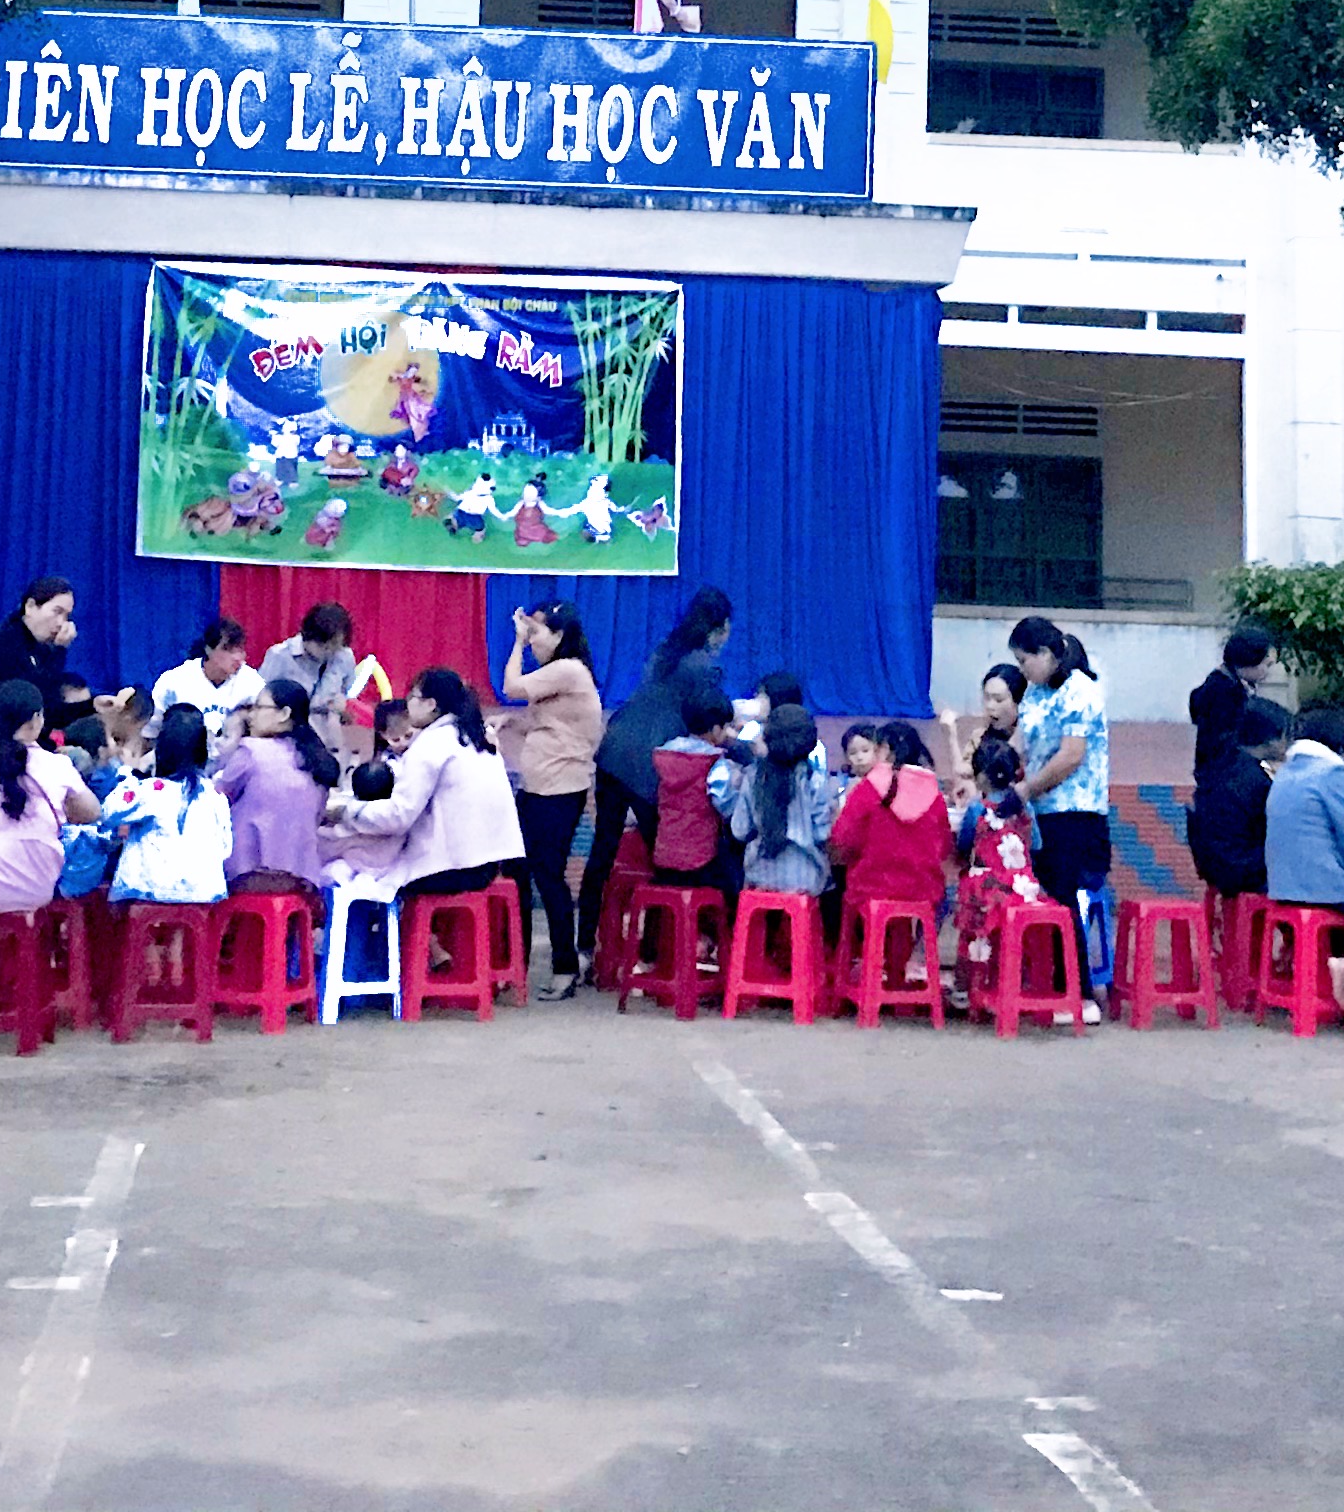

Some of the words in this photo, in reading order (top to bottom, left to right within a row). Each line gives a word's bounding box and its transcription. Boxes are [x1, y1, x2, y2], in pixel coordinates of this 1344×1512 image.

[137, 67, 267, 167] HỌC
[397, 55, 531, 176] HẬU
[547, 83, 679, 184] HỌC
[697, 66, 831, 170] VĂN
